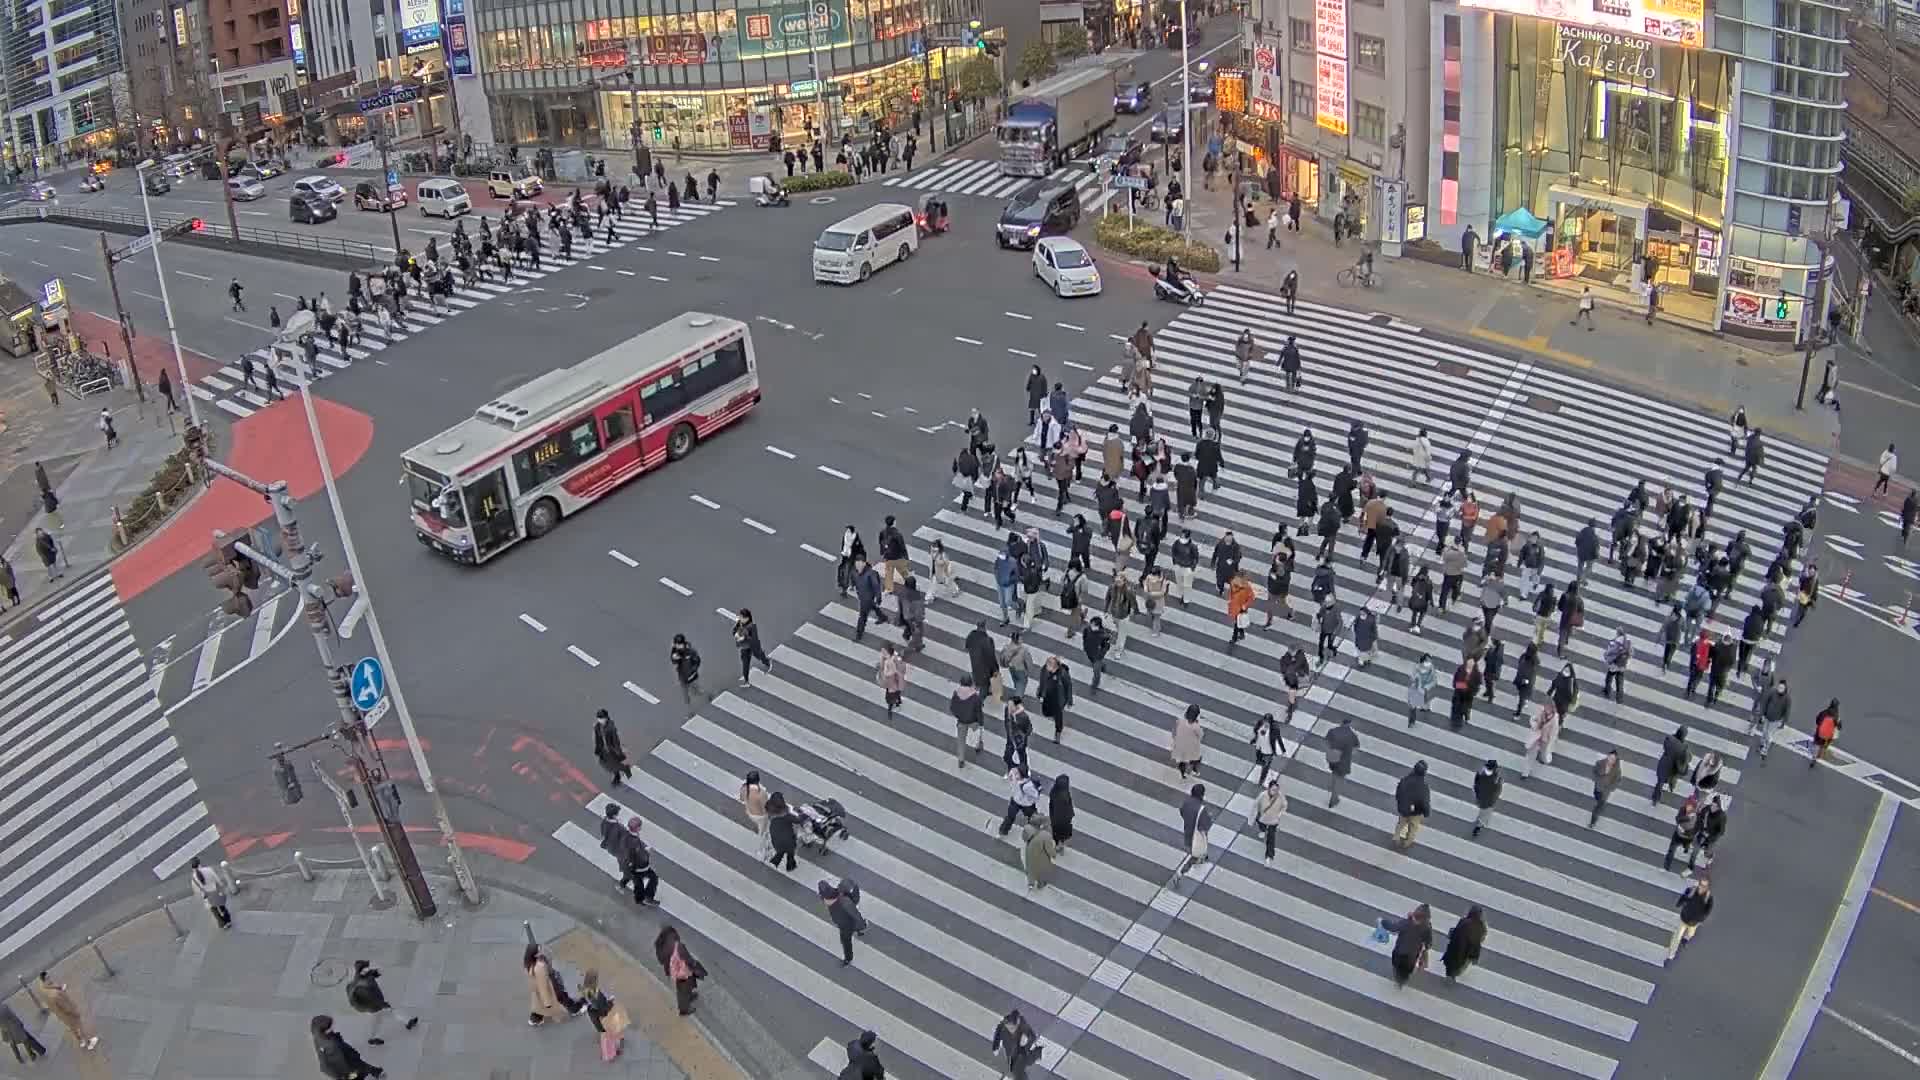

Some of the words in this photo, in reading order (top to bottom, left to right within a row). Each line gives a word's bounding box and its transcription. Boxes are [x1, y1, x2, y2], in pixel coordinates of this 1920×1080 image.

[1556, 22, 1612, 44] PACHINKO
[1614, 36, 1622, 45] &
[1624, 37, 1652, 51] SLOT
[1563, 40, 1656, 79] Kaleido
